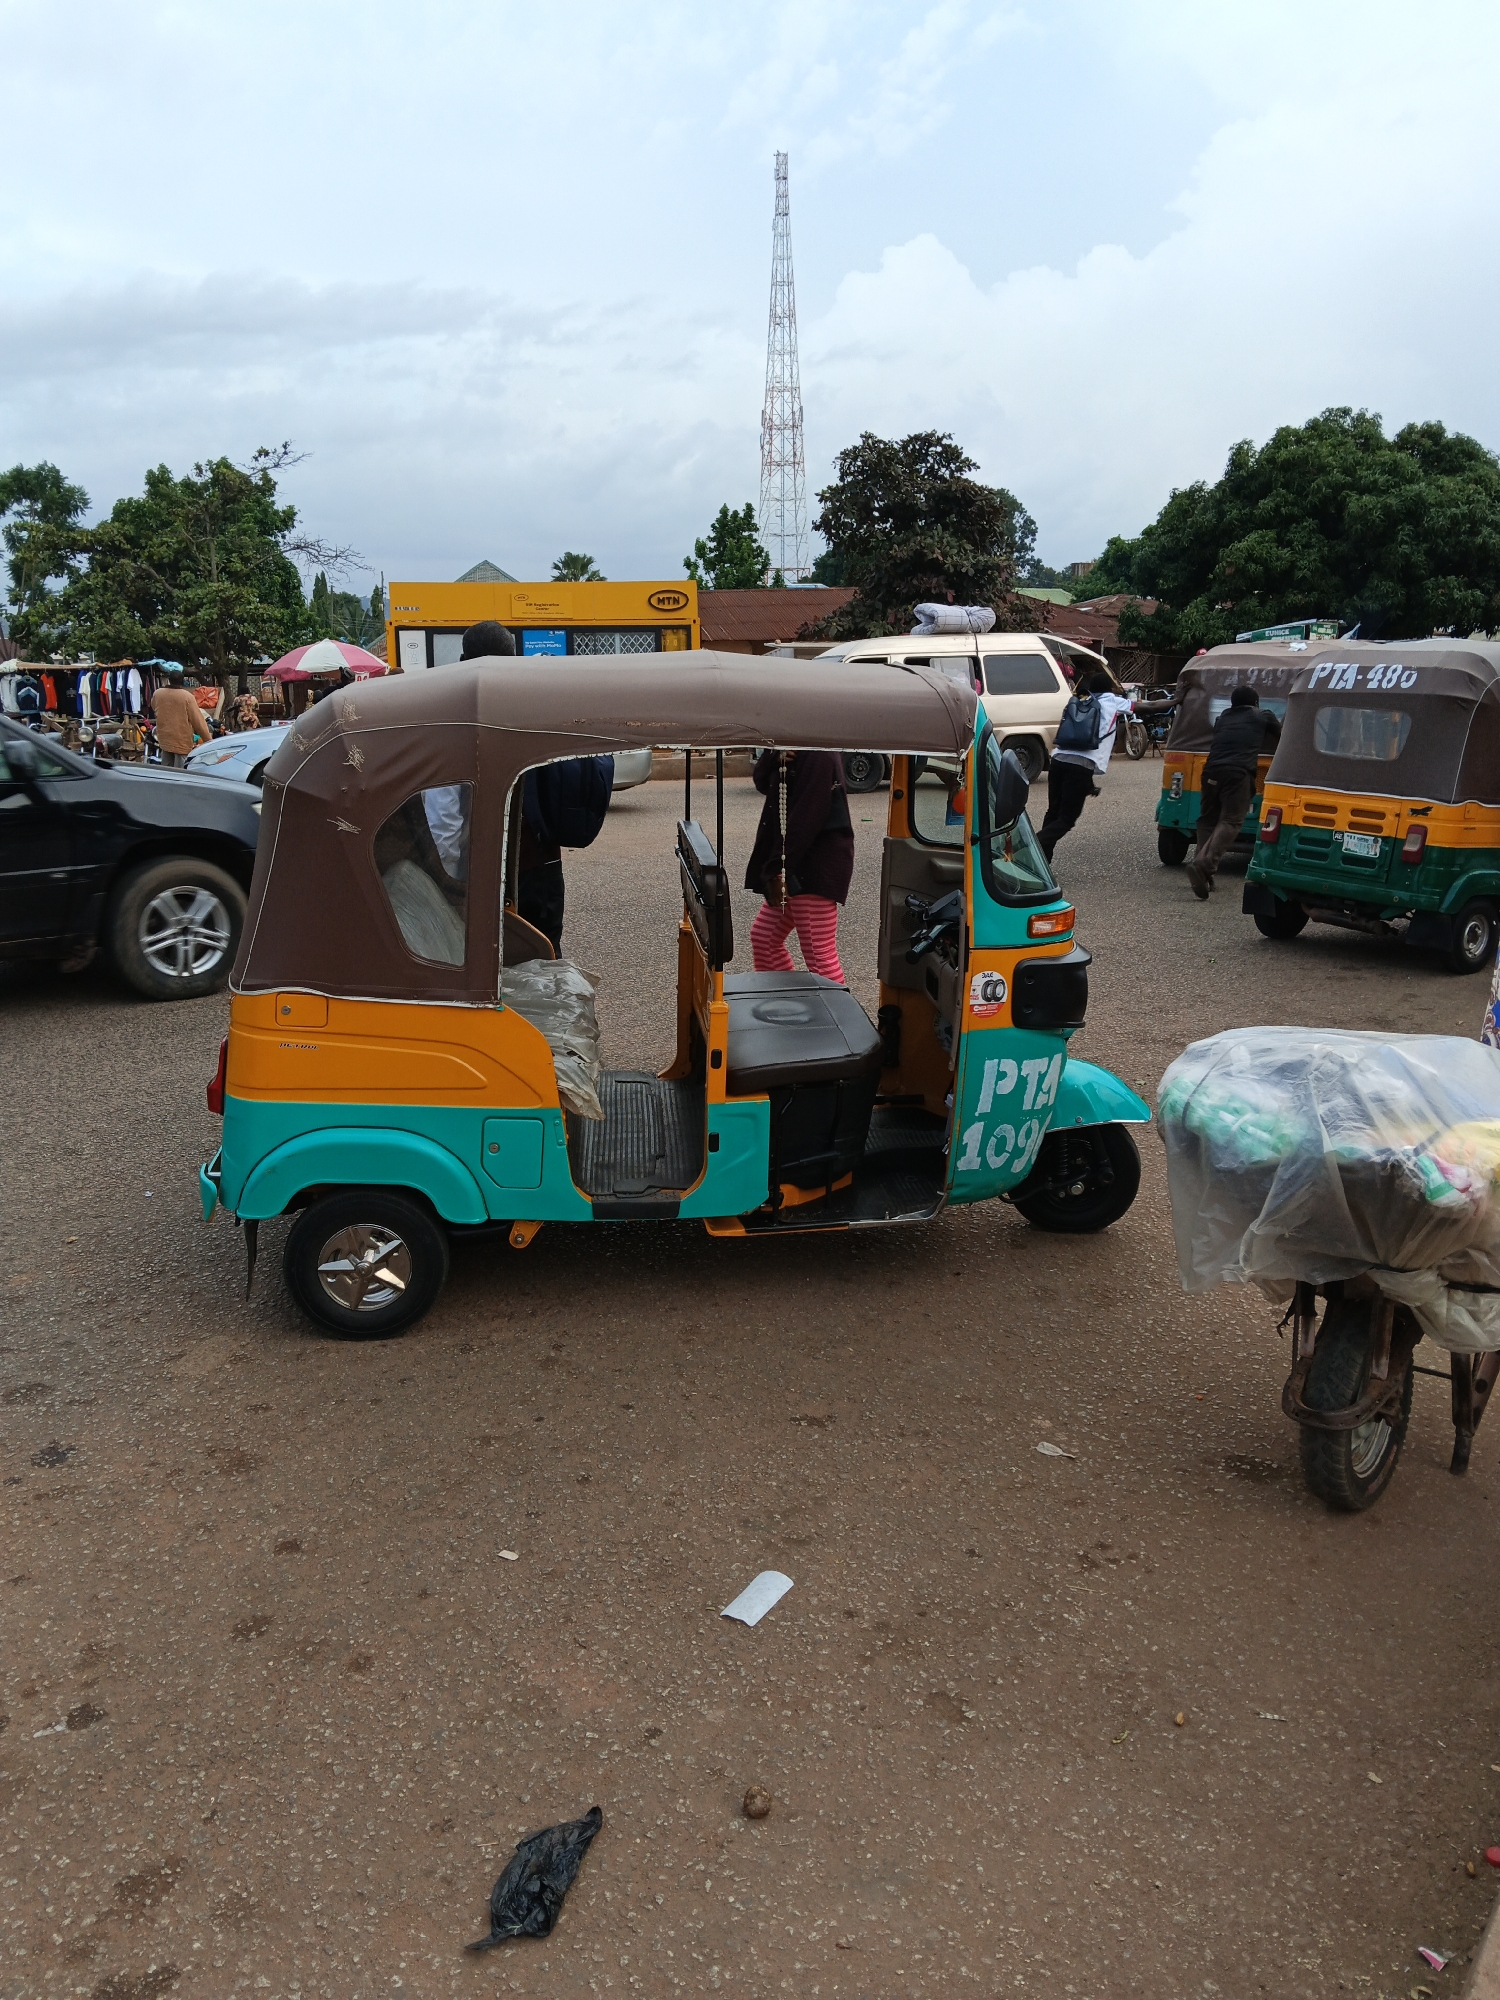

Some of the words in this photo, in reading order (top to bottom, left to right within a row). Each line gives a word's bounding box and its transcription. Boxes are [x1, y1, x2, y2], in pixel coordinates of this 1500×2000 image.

[657, 596, 680, 605] MTN
[1265, 628, 1290, 636] EUNICE
[975, 1052, 1062, 1116] PTA
